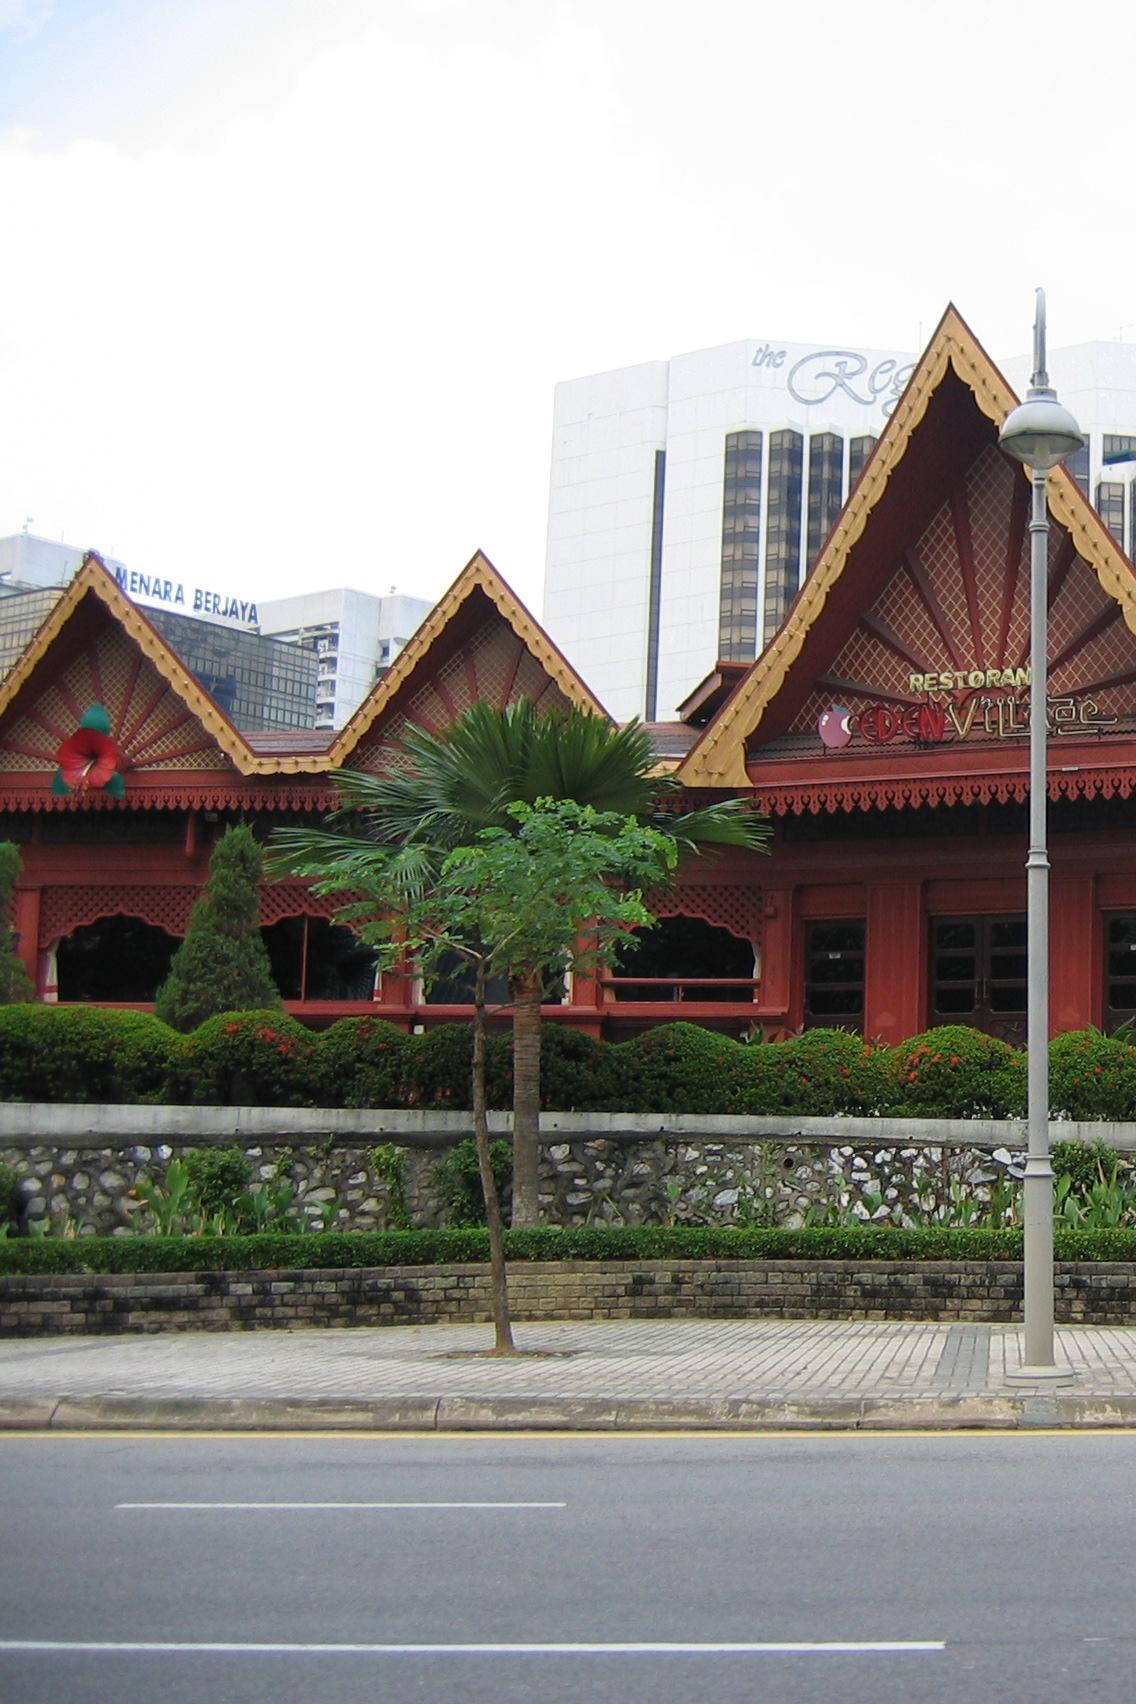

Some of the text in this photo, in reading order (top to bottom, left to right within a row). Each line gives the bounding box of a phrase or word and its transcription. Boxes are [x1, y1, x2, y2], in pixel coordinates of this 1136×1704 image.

[751, 343, 918, 418] the Reg
[115, 566, 259, 625] MENARA BERJAYA
[909, 667, 1032, 692] RESTORAN
[860, 702, 945, 743] EDEN
